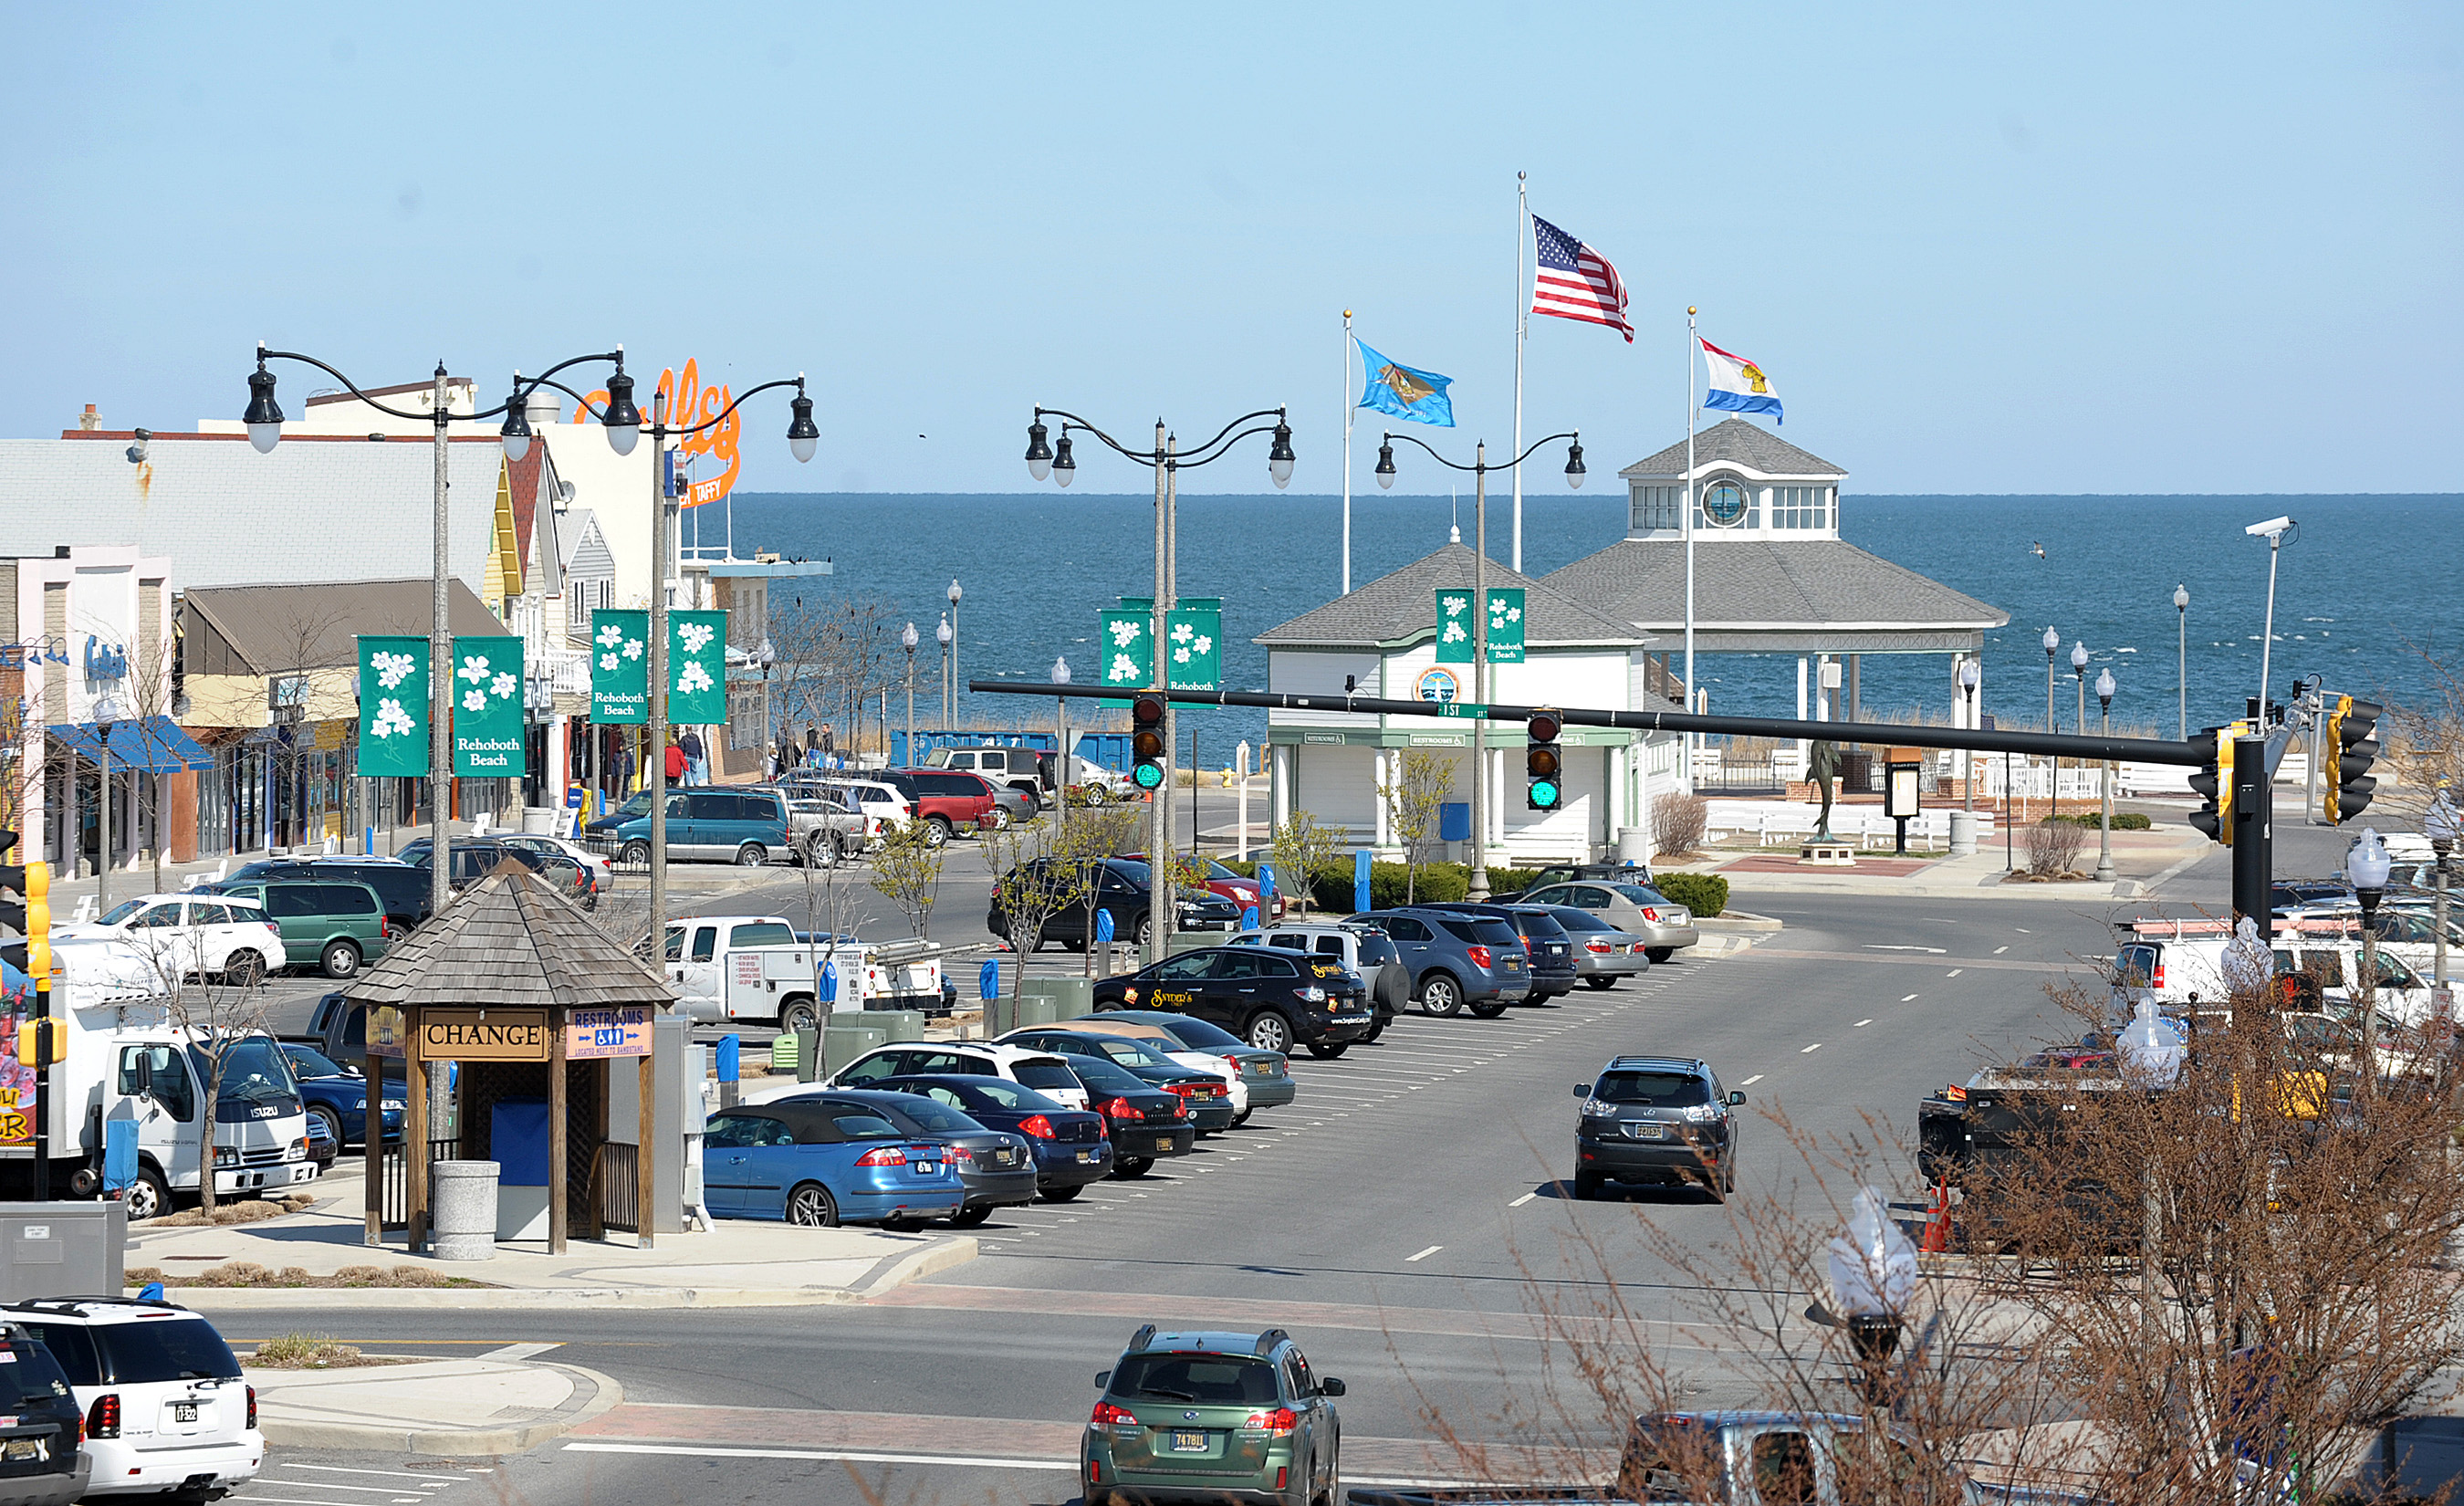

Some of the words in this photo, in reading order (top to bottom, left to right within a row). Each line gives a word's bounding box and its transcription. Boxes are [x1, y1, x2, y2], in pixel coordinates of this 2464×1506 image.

[695, 479, 721, 502] TAFFY
[1488, 642, 1522, 650] Rehoboth
[1170, 681, 1214, 691] Rehoboth
[594, 692, 644, 703] Rehoboth
[603, 704, 635, 716] Beach
[457, 737, 520, 751] Rehoboth
[1414, 737, 1453, 745] RESTROOMS
[469, 753, 508, 766] Beach
[575, 1010, 643, 1029] RESTROOMS
[427, 1024, 541, 1045] CHANGE
[575, 1047, 595, 1056] LOCATED
[596, 1047, 609, 1055] NEXT
[610, 1046, 616, 1054] TO
[617, 1045, 643, 1054] BANDSTAND
[0, 1091, 17, 1105] LI
[251, 1106, 278, 1118] ISUZU
[1176, 1434, 1204, 1446] 747811
